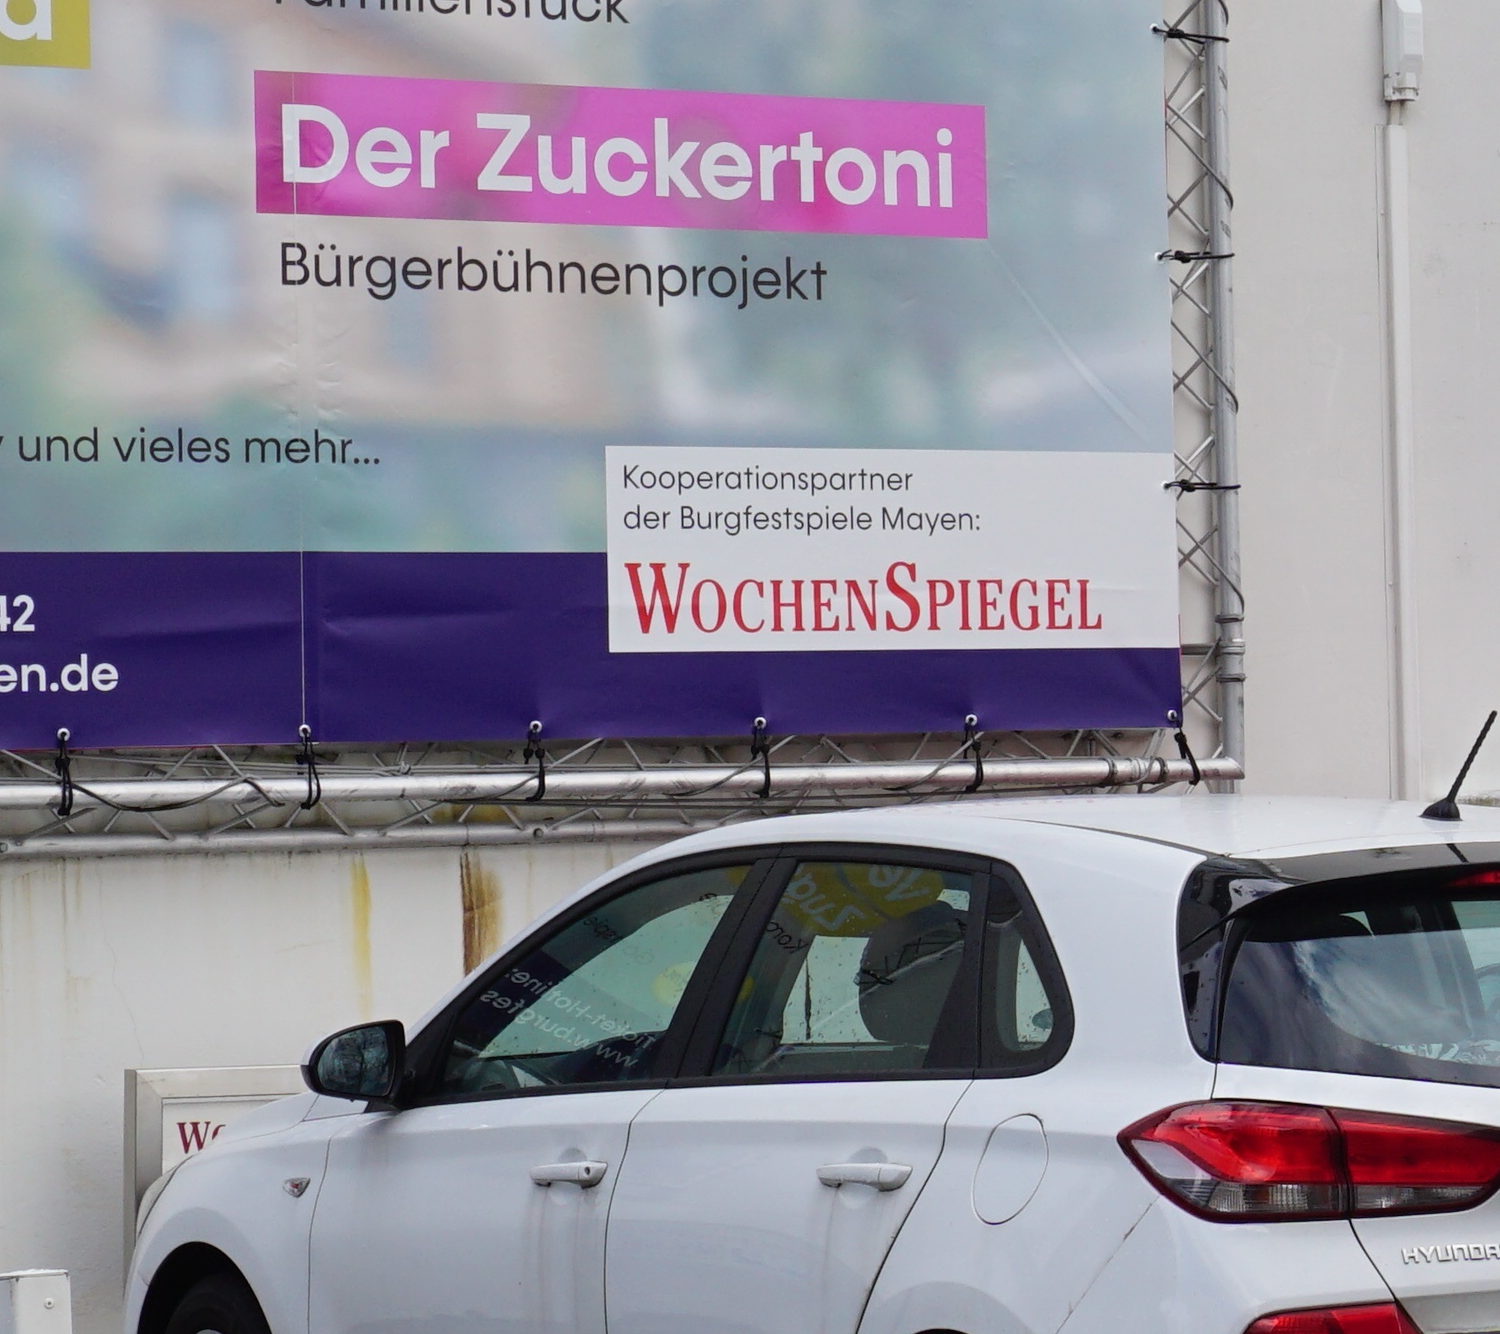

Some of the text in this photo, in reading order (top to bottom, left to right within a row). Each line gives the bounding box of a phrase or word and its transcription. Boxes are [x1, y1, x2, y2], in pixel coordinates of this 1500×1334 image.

[281, 104, 952, 207] Der Zuckertoni
[282, 243, 827, 310] Bürgerbühnenprojekt
[19, 427, 98, 462] und
[113, 427, 230, 463] vieles
[245, 429, 379, 464] mehr...
[624, 465, 913, 496] Kooperationspartner
[624, 504, 980, 536] der Burgfestspiele Mayen:
